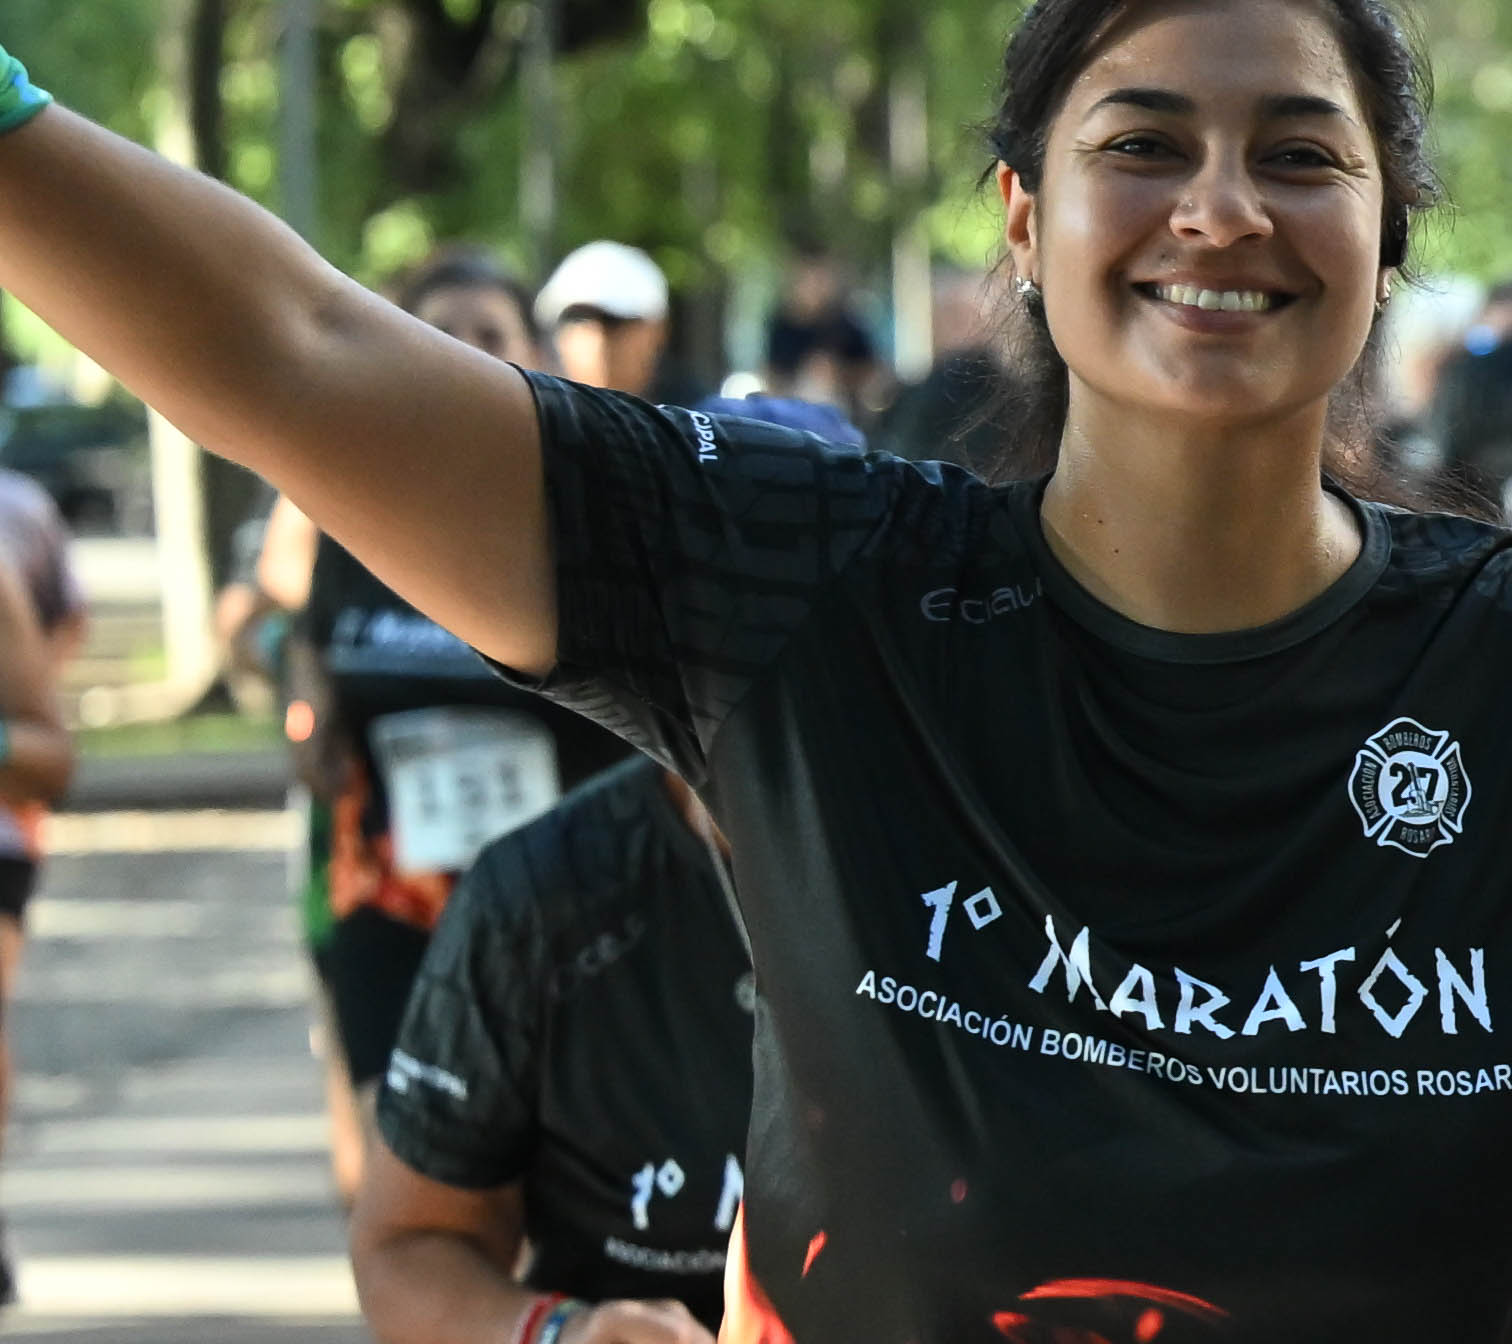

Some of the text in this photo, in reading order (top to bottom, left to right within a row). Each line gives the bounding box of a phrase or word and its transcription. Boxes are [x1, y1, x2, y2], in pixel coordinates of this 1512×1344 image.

[1382, 731, 1432, 751] BOMBEROS
[1389, 761, 1440, 808] 27
[1027, 913, 1494, 1040] MARATÓN
[855, 969, 1034, 1052] ASOCIACIÓN
[1039, 1027, 1203, 1086] BOMBEROS
[1206, 1065, 1410, 1096] VOLUNTARIOS
